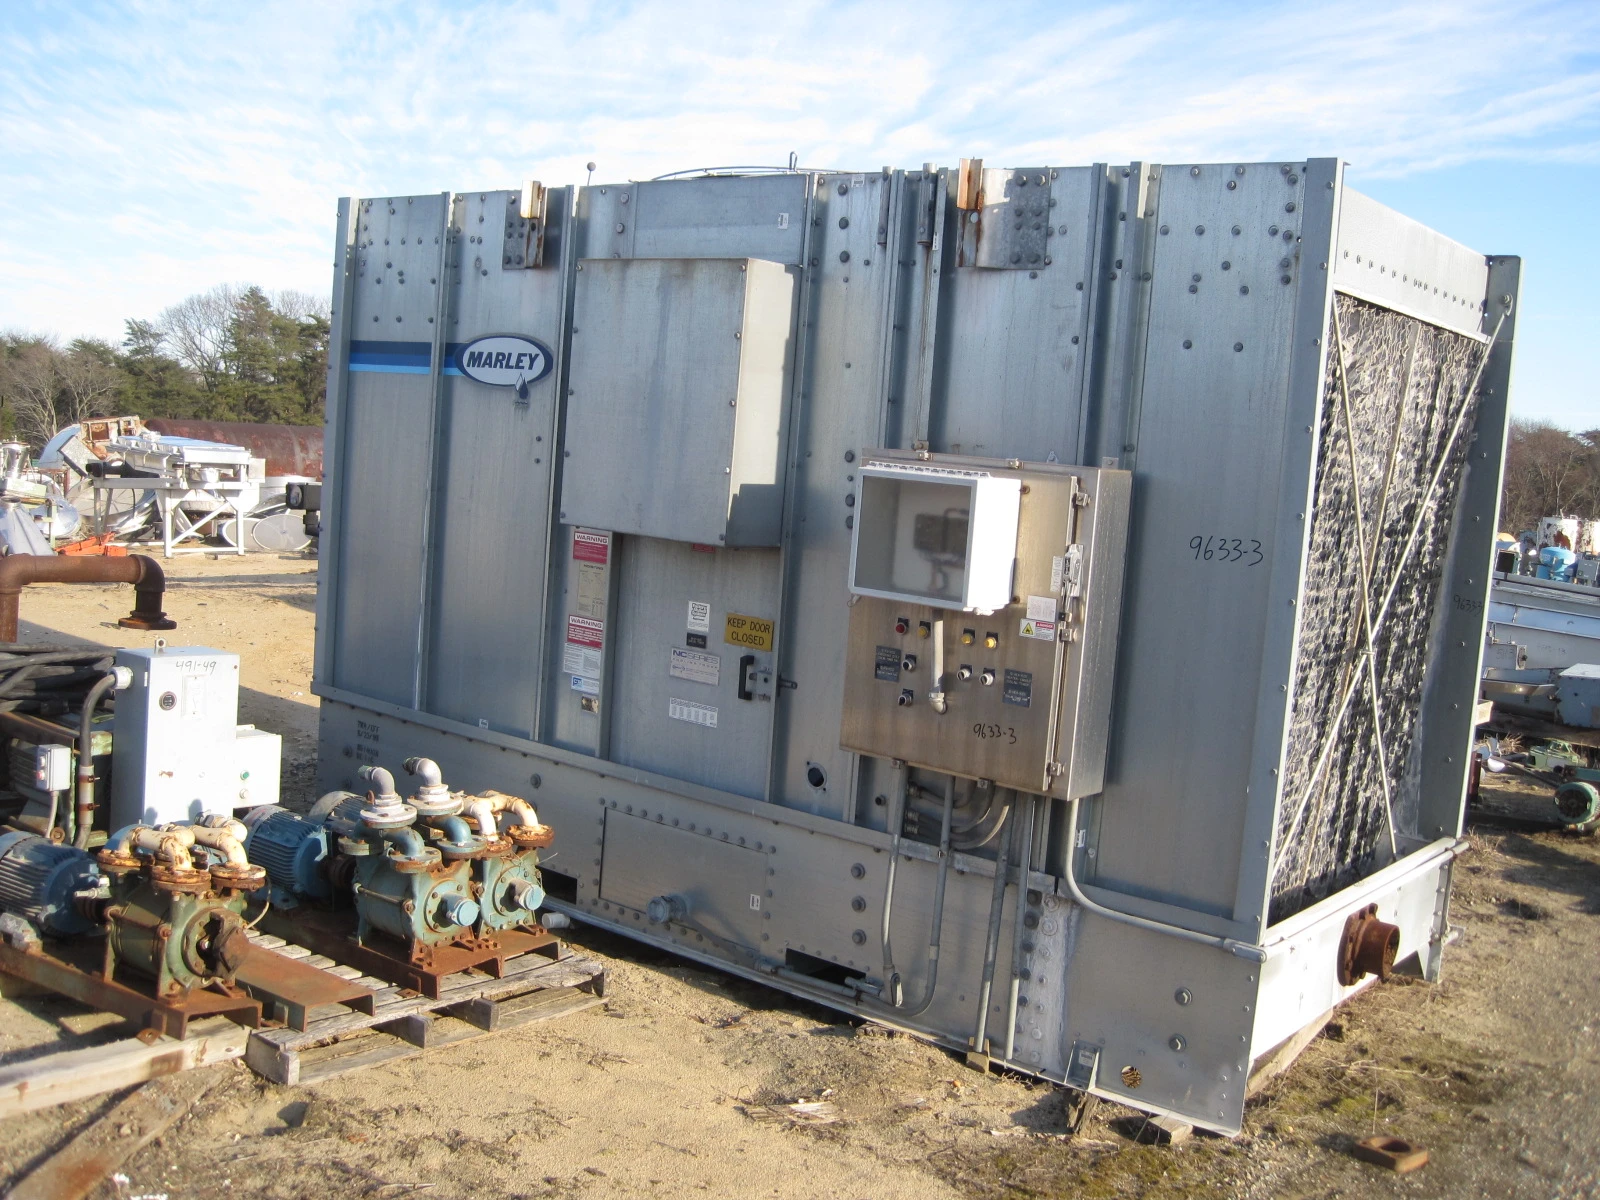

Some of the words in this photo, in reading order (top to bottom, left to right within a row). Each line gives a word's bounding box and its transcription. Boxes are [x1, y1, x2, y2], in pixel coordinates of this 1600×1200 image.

[466, 351, 540, 371] MARLEY
[576, 534, 608, 544] WARNING
[1189, 535, 1264, 566] 9633-3
[571, 616, 602, 629] WARNING
[727, 617, 747, 629] KEEP
[750, 621, 771, 634] DOOR
[731, 630, 765, 646] CLOSED
[175, 660, 217, 676] 491-49
[973, 723, 1017, 745] 9633-3
